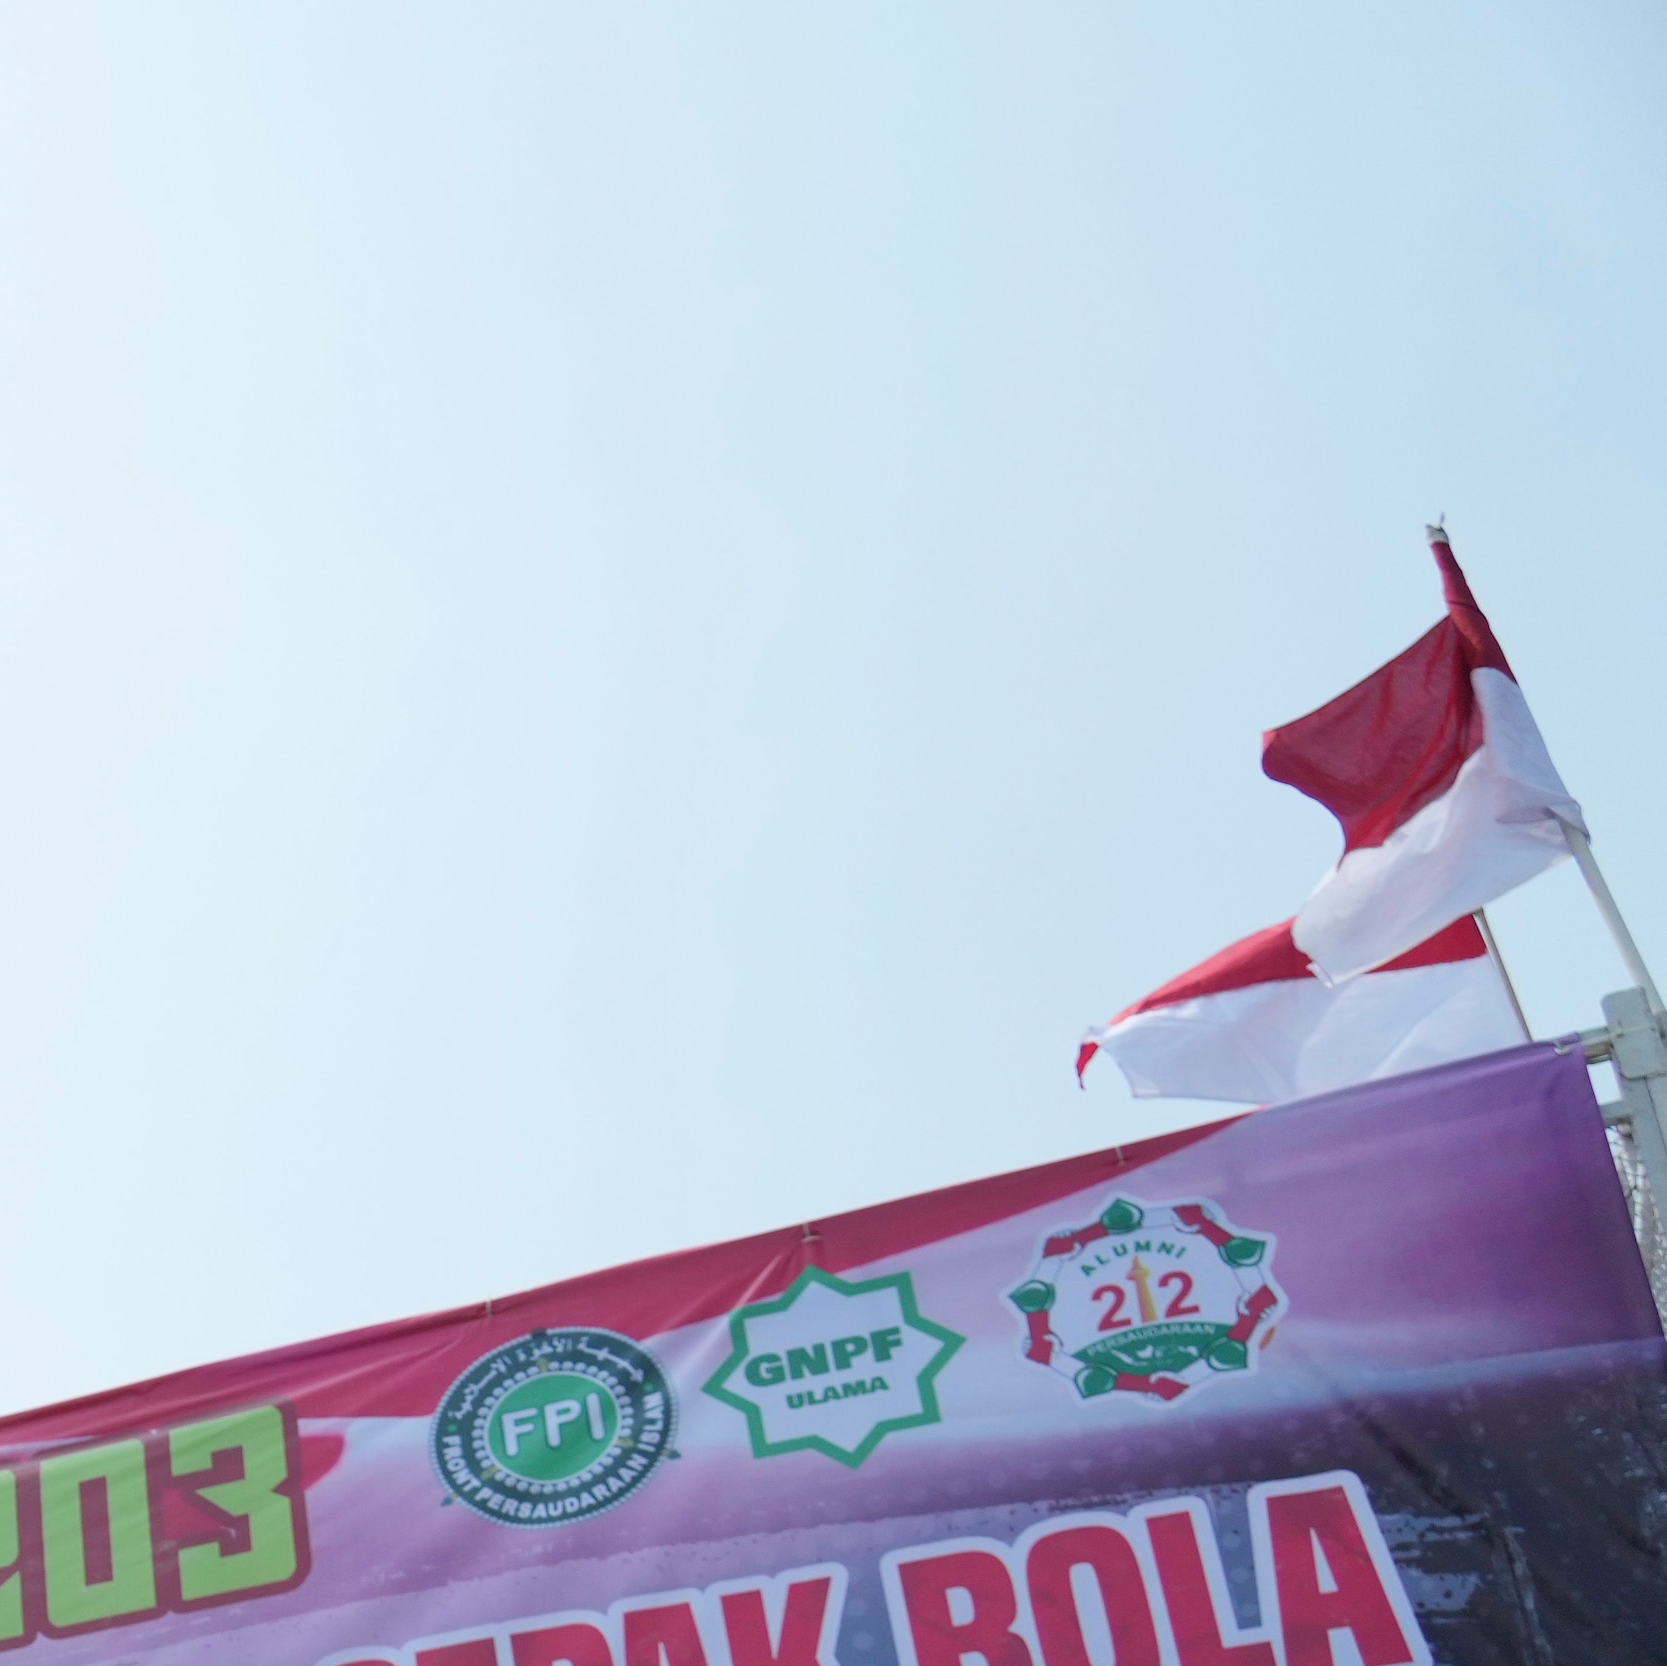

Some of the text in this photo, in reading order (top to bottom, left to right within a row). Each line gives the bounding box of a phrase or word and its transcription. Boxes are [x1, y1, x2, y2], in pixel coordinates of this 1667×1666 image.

[1080, 1239, 1187, 1277] ALUMNI
[743, 1326, 903, 1388] GNPF
[785, 1375, 890, 1409] ULAMA
[442, 1390, 665, 1520] FRONT PERSAUDARAAN ISLAM
[500, 1391, 606, 1457] FPI
